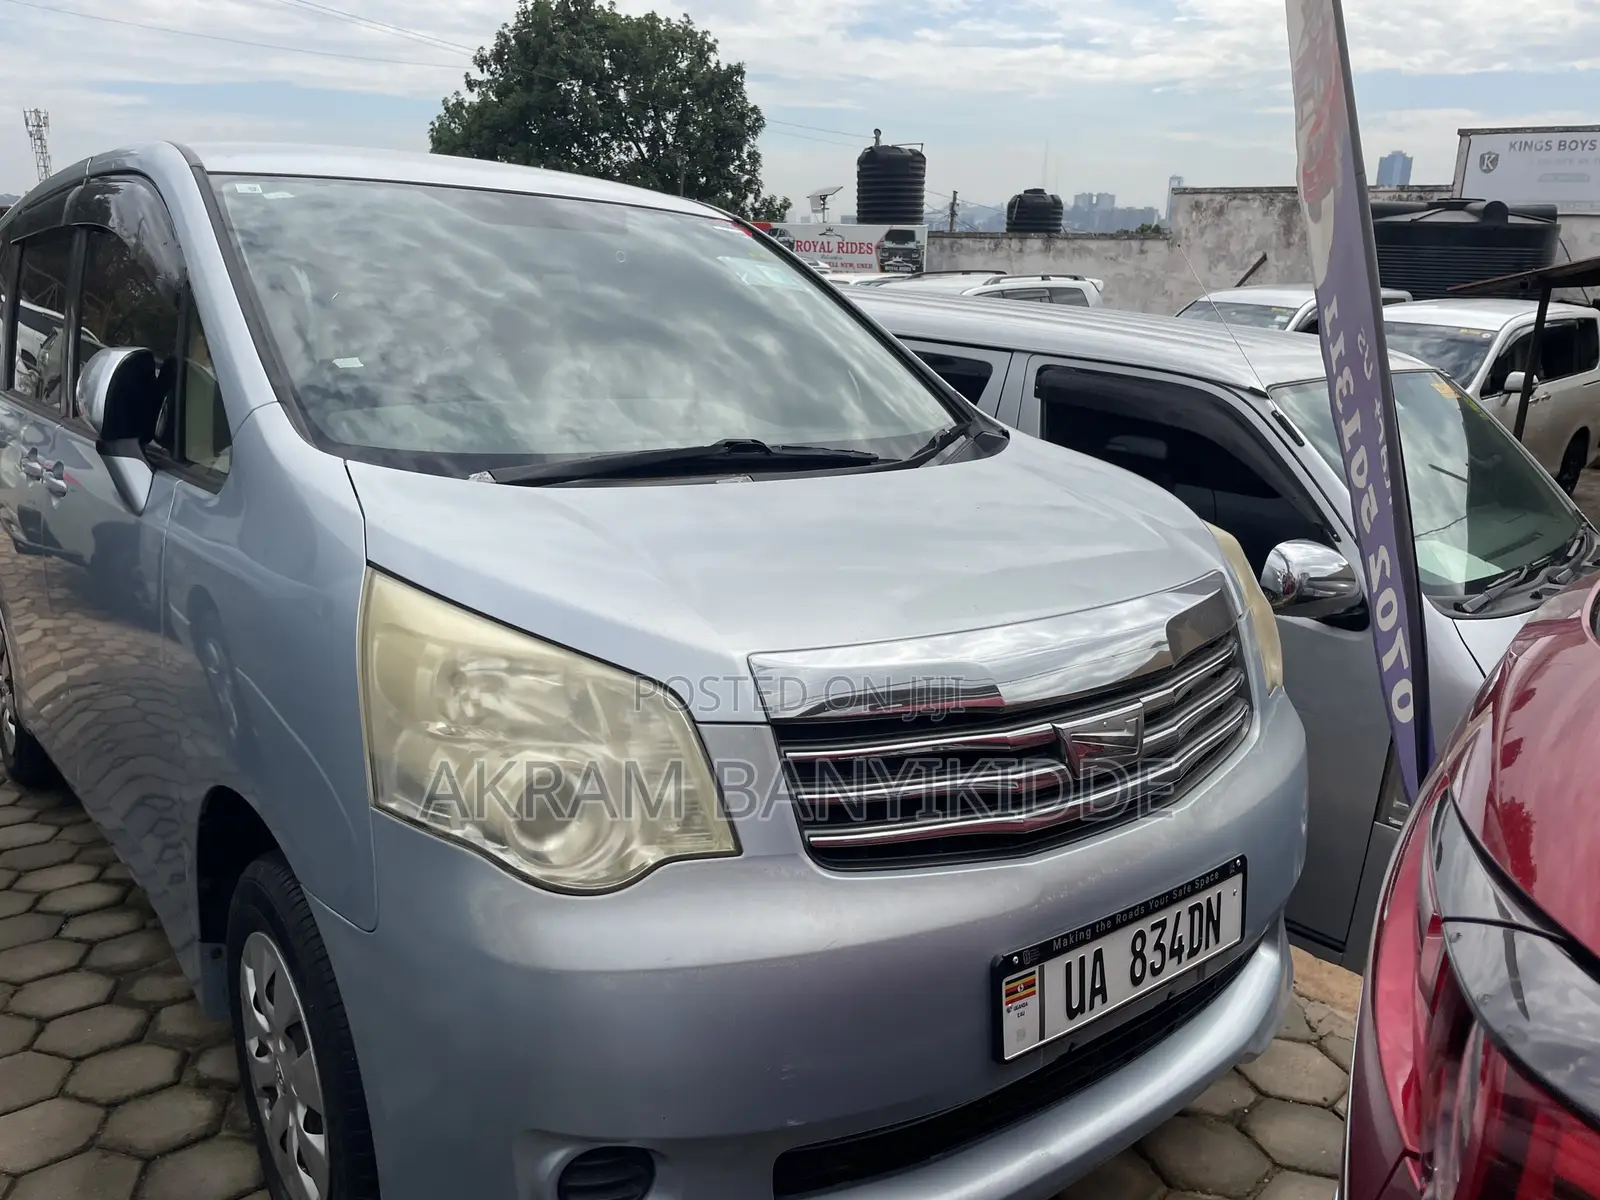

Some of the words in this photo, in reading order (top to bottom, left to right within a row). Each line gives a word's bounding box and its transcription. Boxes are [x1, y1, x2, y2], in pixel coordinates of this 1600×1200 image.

[1508, 140, 1553, 152] KINGS
[1557, 139, 1598, 151] BOYS
[1482, 154, 1496, 170] K
[796, 239, 833, 254] ROYAL
[837, 240, 873, 255] RIDES
[1053, 928, 1092, 951] Making
[1096, 920, 1112, 932] the
[1115, 906, 1145, 924] Roads
[1148, 895, 1168, 909] Your
[1172, 884, 1192, 899] Safe
[1194, 871, 1219, 889] Space
[1065, 947, 1108, 1021] UA
[1129, 891, 1222, 987] 834DN
